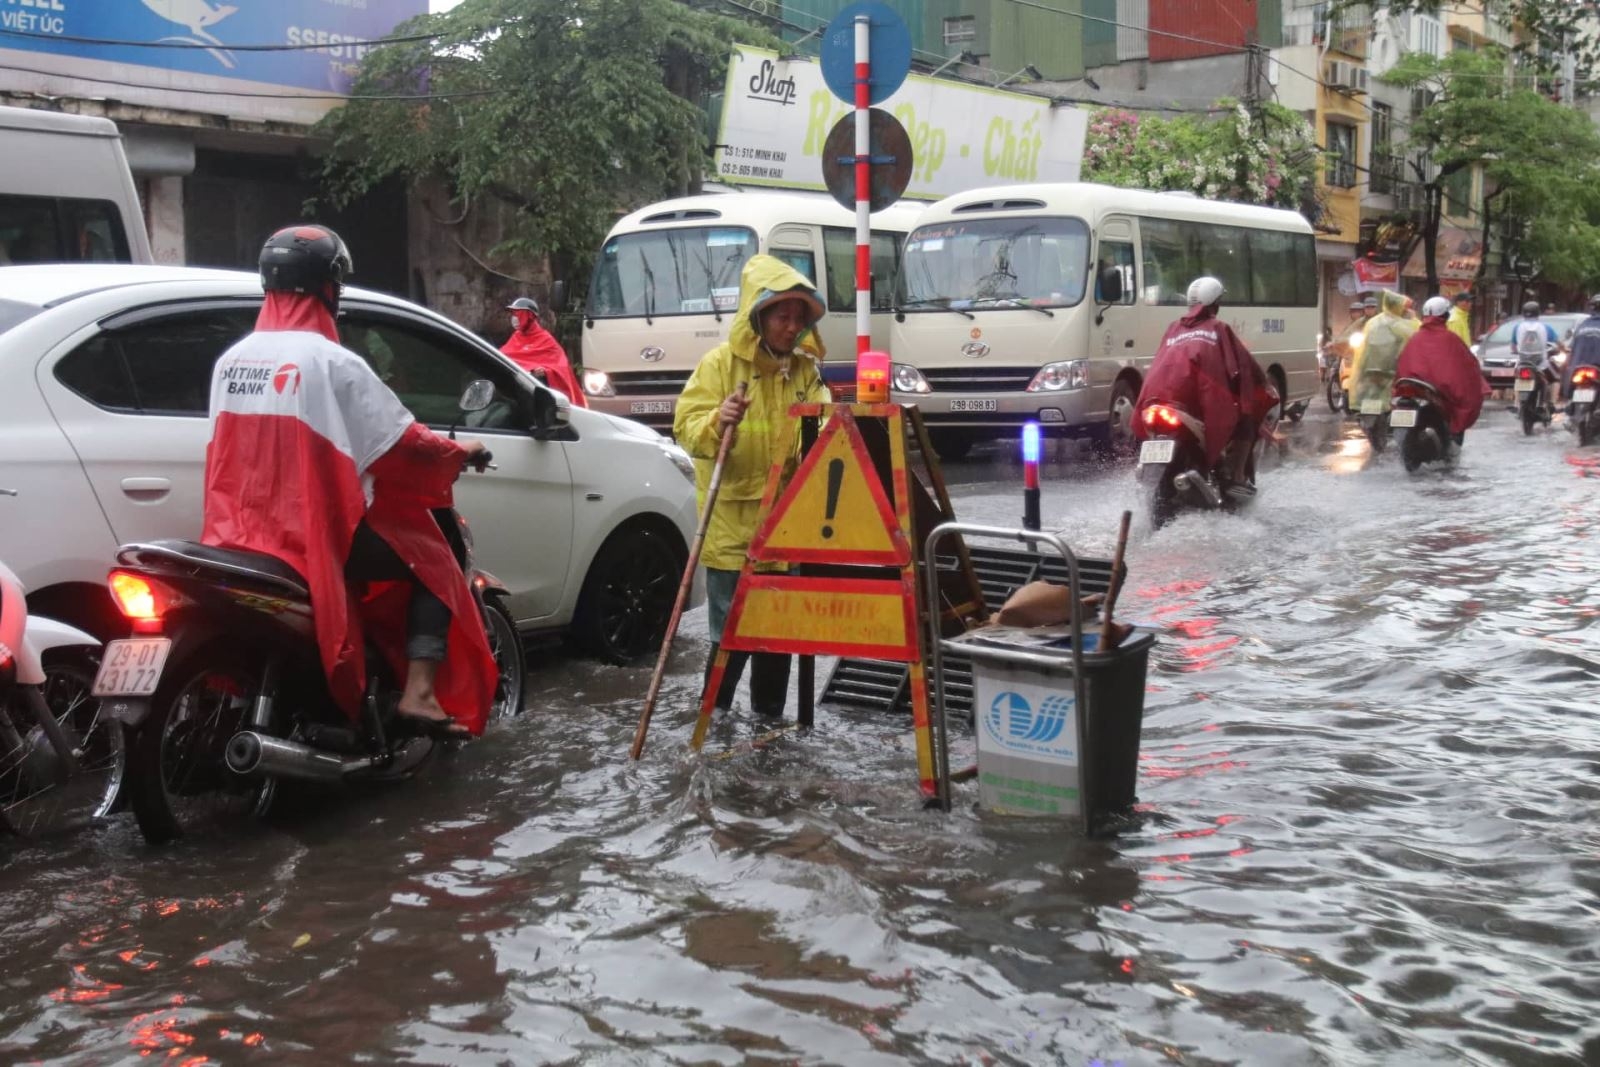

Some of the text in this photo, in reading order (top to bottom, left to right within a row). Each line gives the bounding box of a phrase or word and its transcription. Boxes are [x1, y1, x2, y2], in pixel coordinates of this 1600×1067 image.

[2, 9, 65, 34] VIỆT ÚC
[749, 59, 796, 105] Shop
[983, 109, 1042, 182] Chất
[755, 149, 771, 161] MINH
[772, 151, 787, 162] KHAI
[751, 166, 768, 177] MINH
[768, 168, 784, 178] KHAI
[228, 382, 267, 395] BANK
